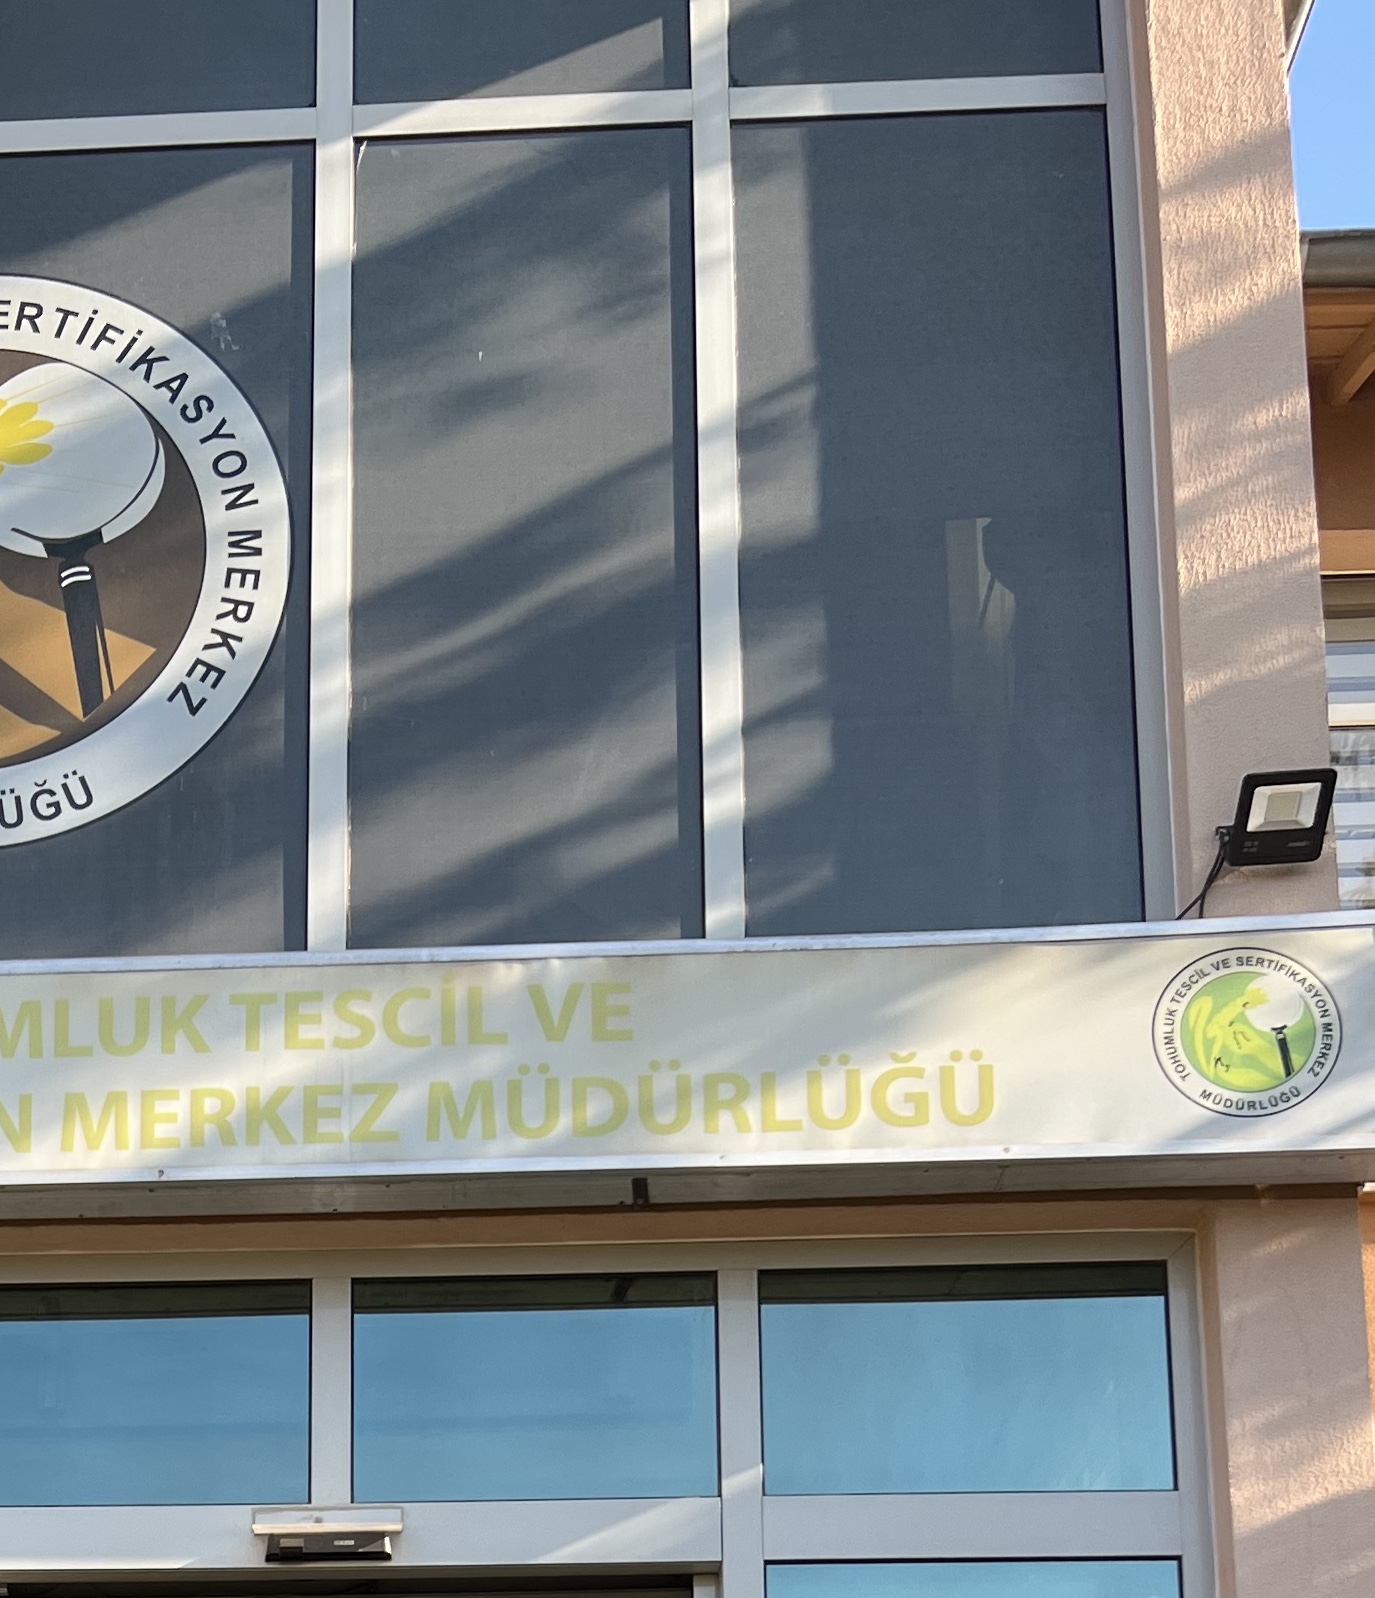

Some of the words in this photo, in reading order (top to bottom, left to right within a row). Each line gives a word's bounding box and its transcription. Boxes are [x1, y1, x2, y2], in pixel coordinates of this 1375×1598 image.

[166, 528, 264, 717] MERKEZ
[1170, 969, 1211, 1005] TESCİL
[1211, 957, 1231, 971] VE
[1235, 955, 1331, 1019] SERTİFİKASYON
[228, 971, 509, 1052] TESCİL
[527, 981, 635, 1044] VE
[1163, 1007, 1191, 1082] TOHUMLUK
[1307, 1022, 1334, 1078] MERKEZ
[59, 1081, 401, 1152] MERKEZ
[425, 1047, 998, 1143] MÜDÜRLÜĞÜ
[1199, 1085, 1301, 1111] MÜDÜRLÜĞÜ
